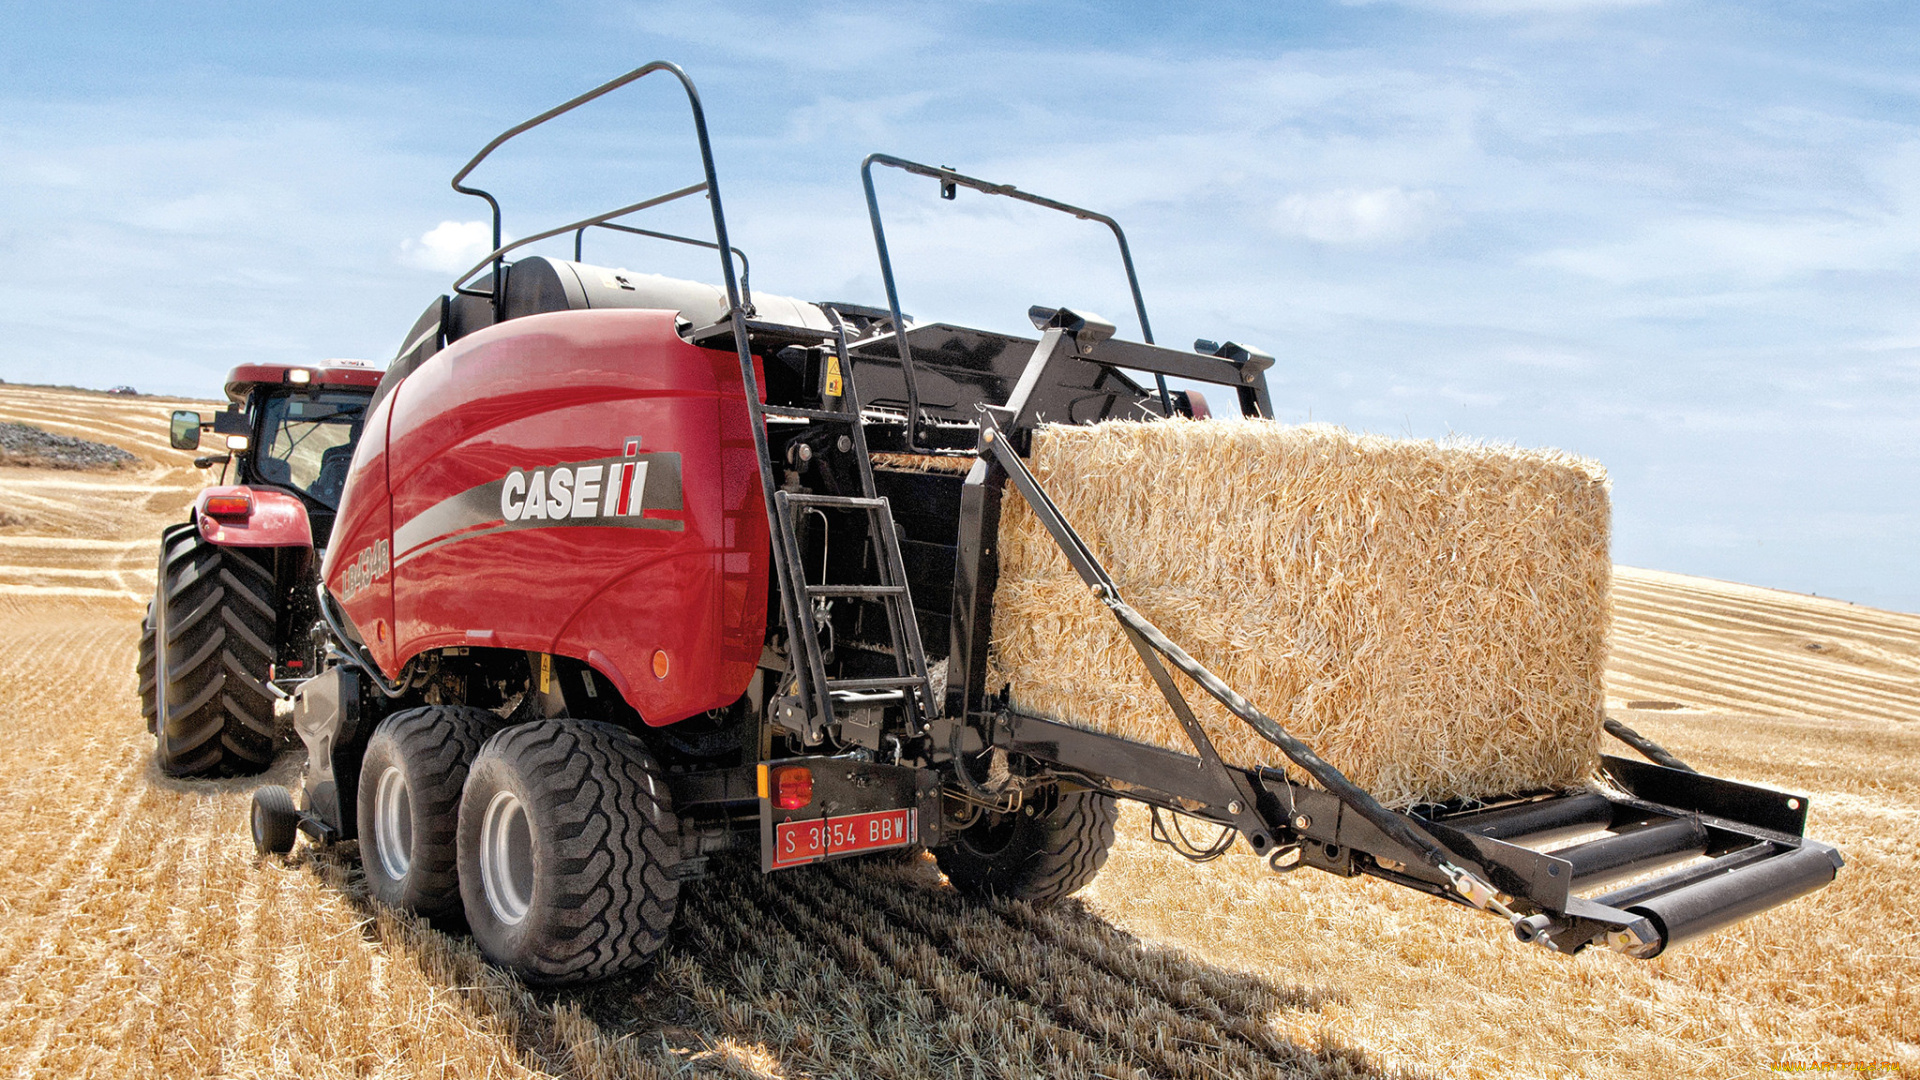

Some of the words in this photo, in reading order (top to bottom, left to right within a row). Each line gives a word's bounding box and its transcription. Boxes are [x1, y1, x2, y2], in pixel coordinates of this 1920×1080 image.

[501, 466, 603, 521] CASE
[342, 538, 390, 603] LB434R
[785, 830, 796, 853] S
[809, 823, 856, 850] 3654
[869, 817, 904, 842] BBW
